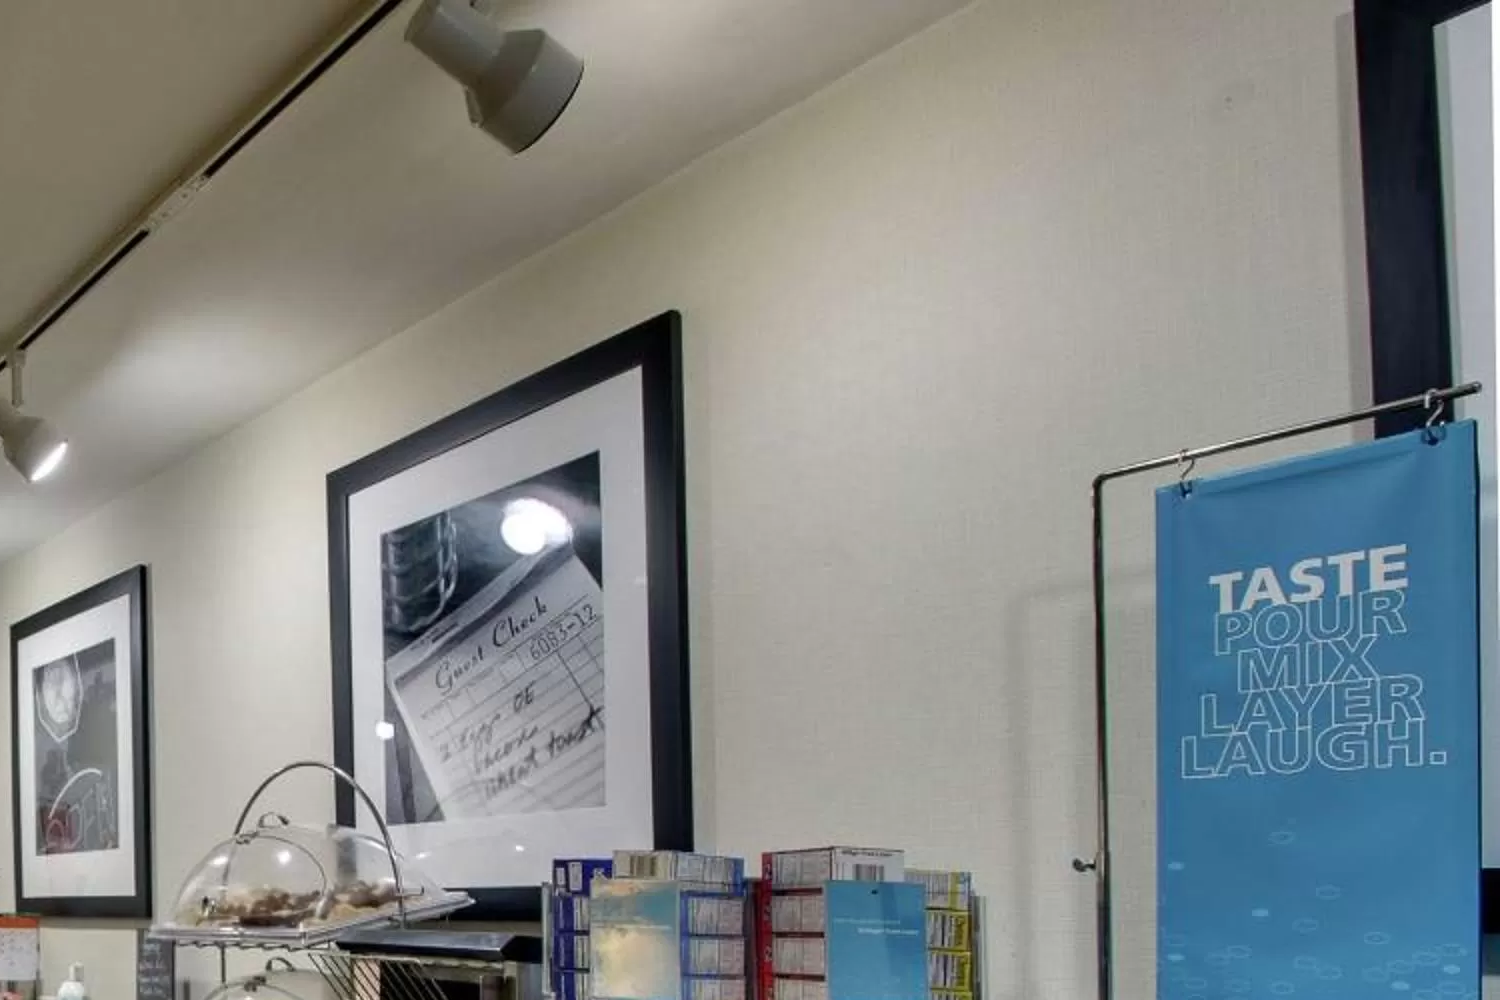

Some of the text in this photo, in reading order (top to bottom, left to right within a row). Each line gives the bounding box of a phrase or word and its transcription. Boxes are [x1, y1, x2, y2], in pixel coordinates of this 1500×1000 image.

[1209, 544, 1408, 614] TASTE
[434, 644, 484, 695] Guest
[491, 596, 547, 648] Check
[1215, 588, 1407, 656] POUR
[1238, 633, 1379, 693] MIX
[1201, 674, 1425, 738] LAYER
[1181, 719, 1447, 779] LAUGH.
